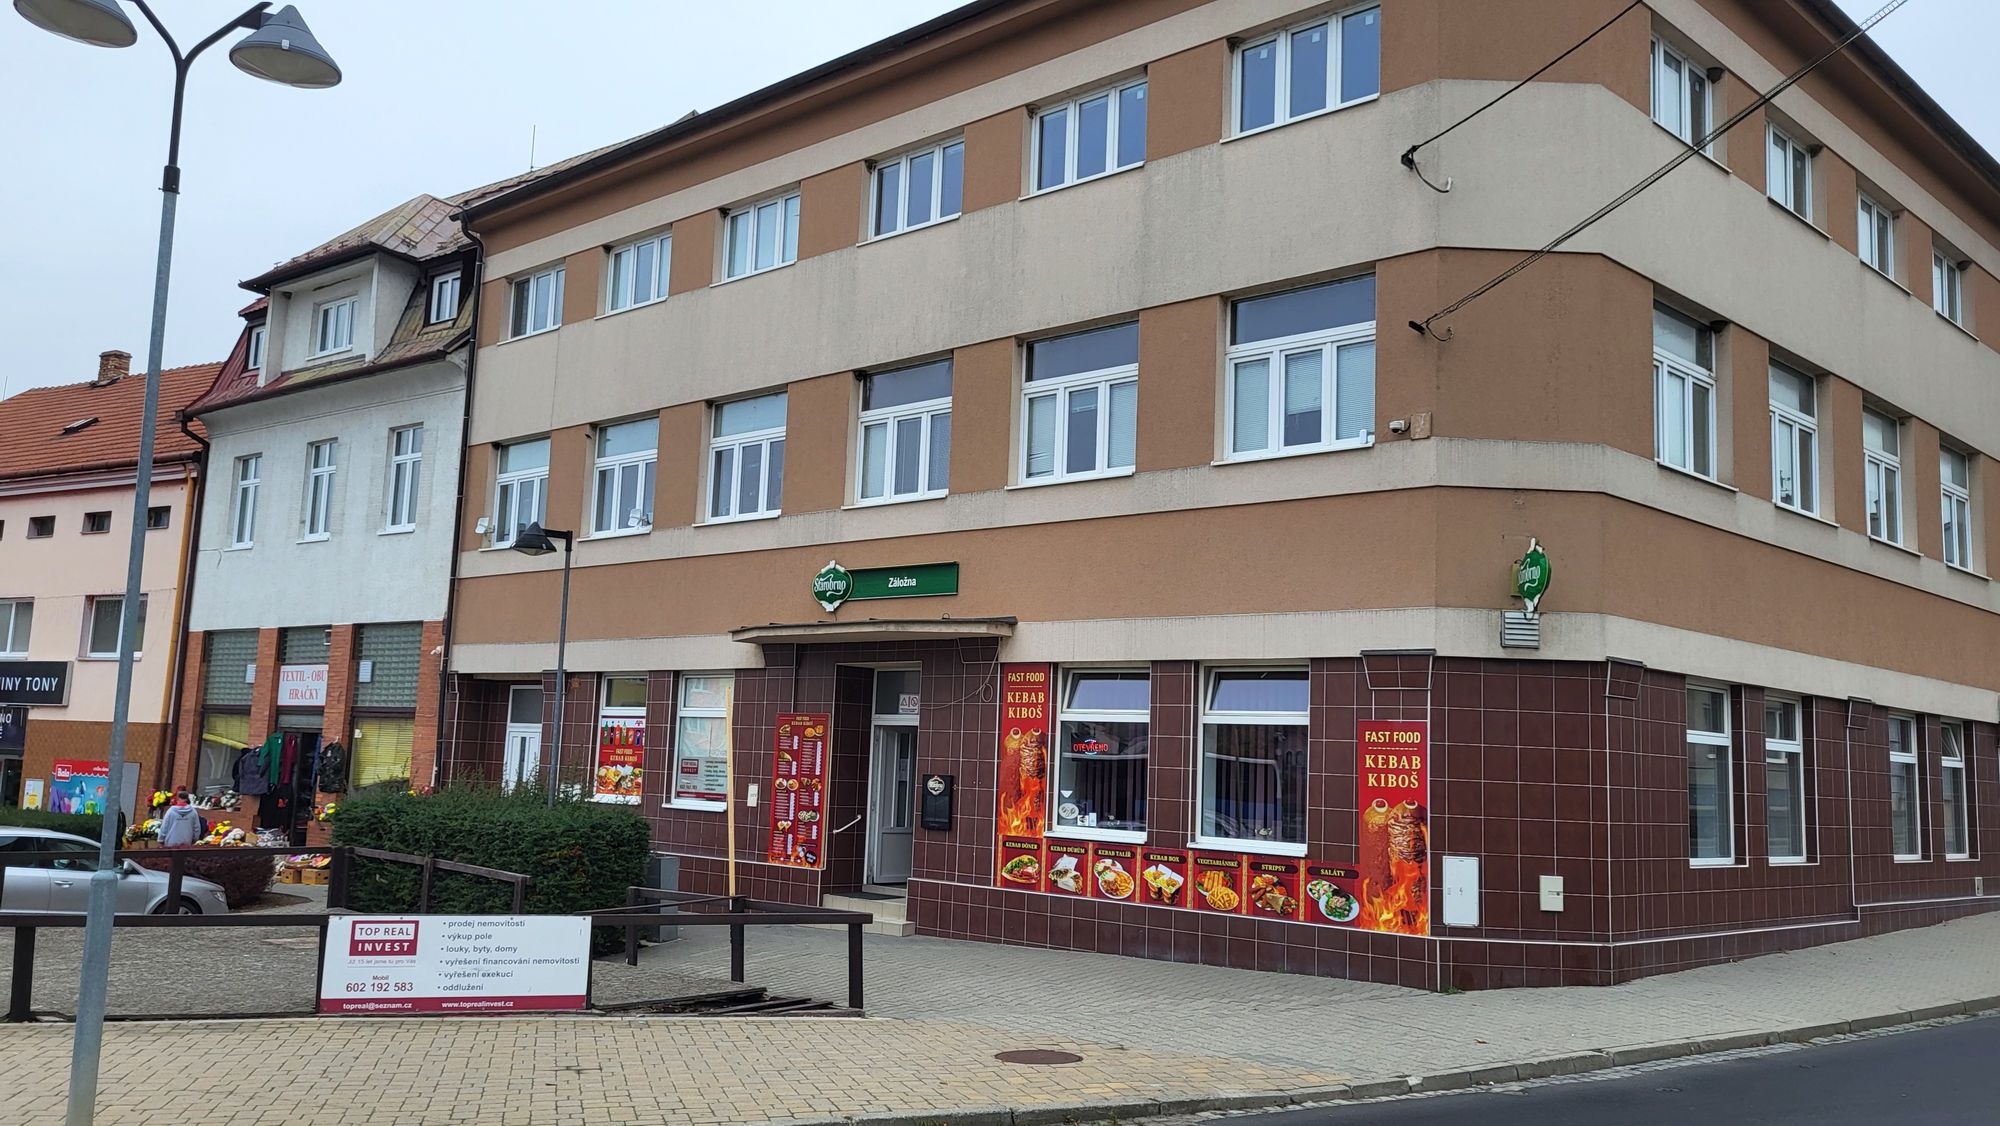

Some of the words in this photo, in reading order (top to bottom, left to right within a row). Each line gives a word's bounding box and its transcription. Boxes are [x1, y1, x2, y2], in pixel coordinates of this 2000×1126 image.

[888, 576, 916, 588] Záložna
[282, 670, 306, 682] TEXTIL
[1008, 672, 1024, 682] FAST
[1026, 672, 1045, 682] FOOD
[0, 676, 22, 691] INY
[26, 677, 58, 692] TONY
[288, 685, 320, 700] HRAČKY
[1007, 692, 1045, 704] KEBAB
[1008, 705, 1043, 718] KIBOŠ
[1365, 731, 1390, 742] FAST
[1394, 732, 1421, 743] FOOD
[1073, 742, 1108, 752] OTEVŘENO
[1364, 754, 1421, 769] KEBAB
[1368, 772, 1419, 788] KIBOŠ
[1261, 864, 1286, 872] STRIPSY
[1320, 868, 1346, 877] SALÁTY
[448, 920, 475, 928] prodej
[359, 928, 380, 936] TOP
[384, 928, 411, 936] REAL
[447, 932, 472, 941] výkup
[358, 942, 410, 952] INVEST
[445, 958, 480, 966] vyřešení
[444, 970, 480, 979] vyřešení
[346, 982, 366, 992] 602
[370, 982, 390, 992] 192
[393, 982, 413, 992] 583
[441, 1001, 514, 1009] www.toprealinvest.cz
